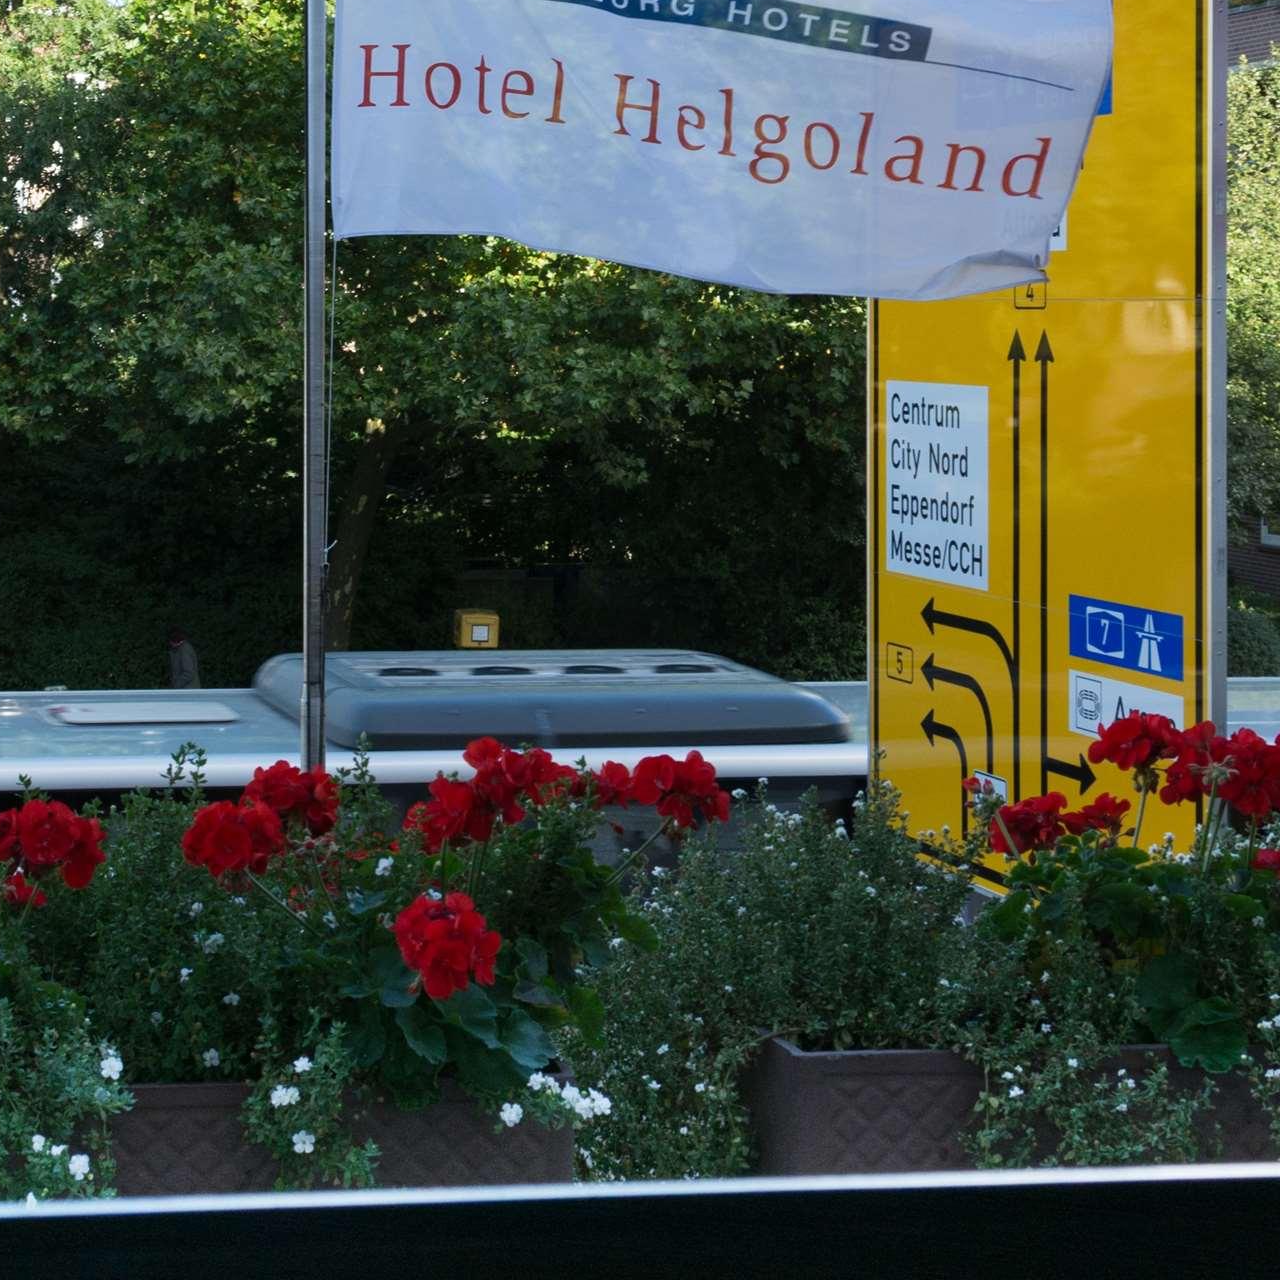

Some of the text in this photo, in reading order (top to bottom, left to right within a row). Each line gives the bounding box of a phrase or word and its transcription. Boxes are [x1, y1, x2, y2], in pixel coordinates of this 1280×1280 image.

[727, 0, 912, 53] HOTELS
[357, 44, 1052, 200] Hotel Helgoland
[1025, 282, 1035, 302] 4
[890, 392, 961, 430] Centrum
[890, 438, 969, 480] City Nord
[890, 483, 975, 527] Eppendorf
[890, 529, 984, 578] Messe/CCH
[1100, 618, 1110, 646] 7
[895, 650, 904, 675] 5
